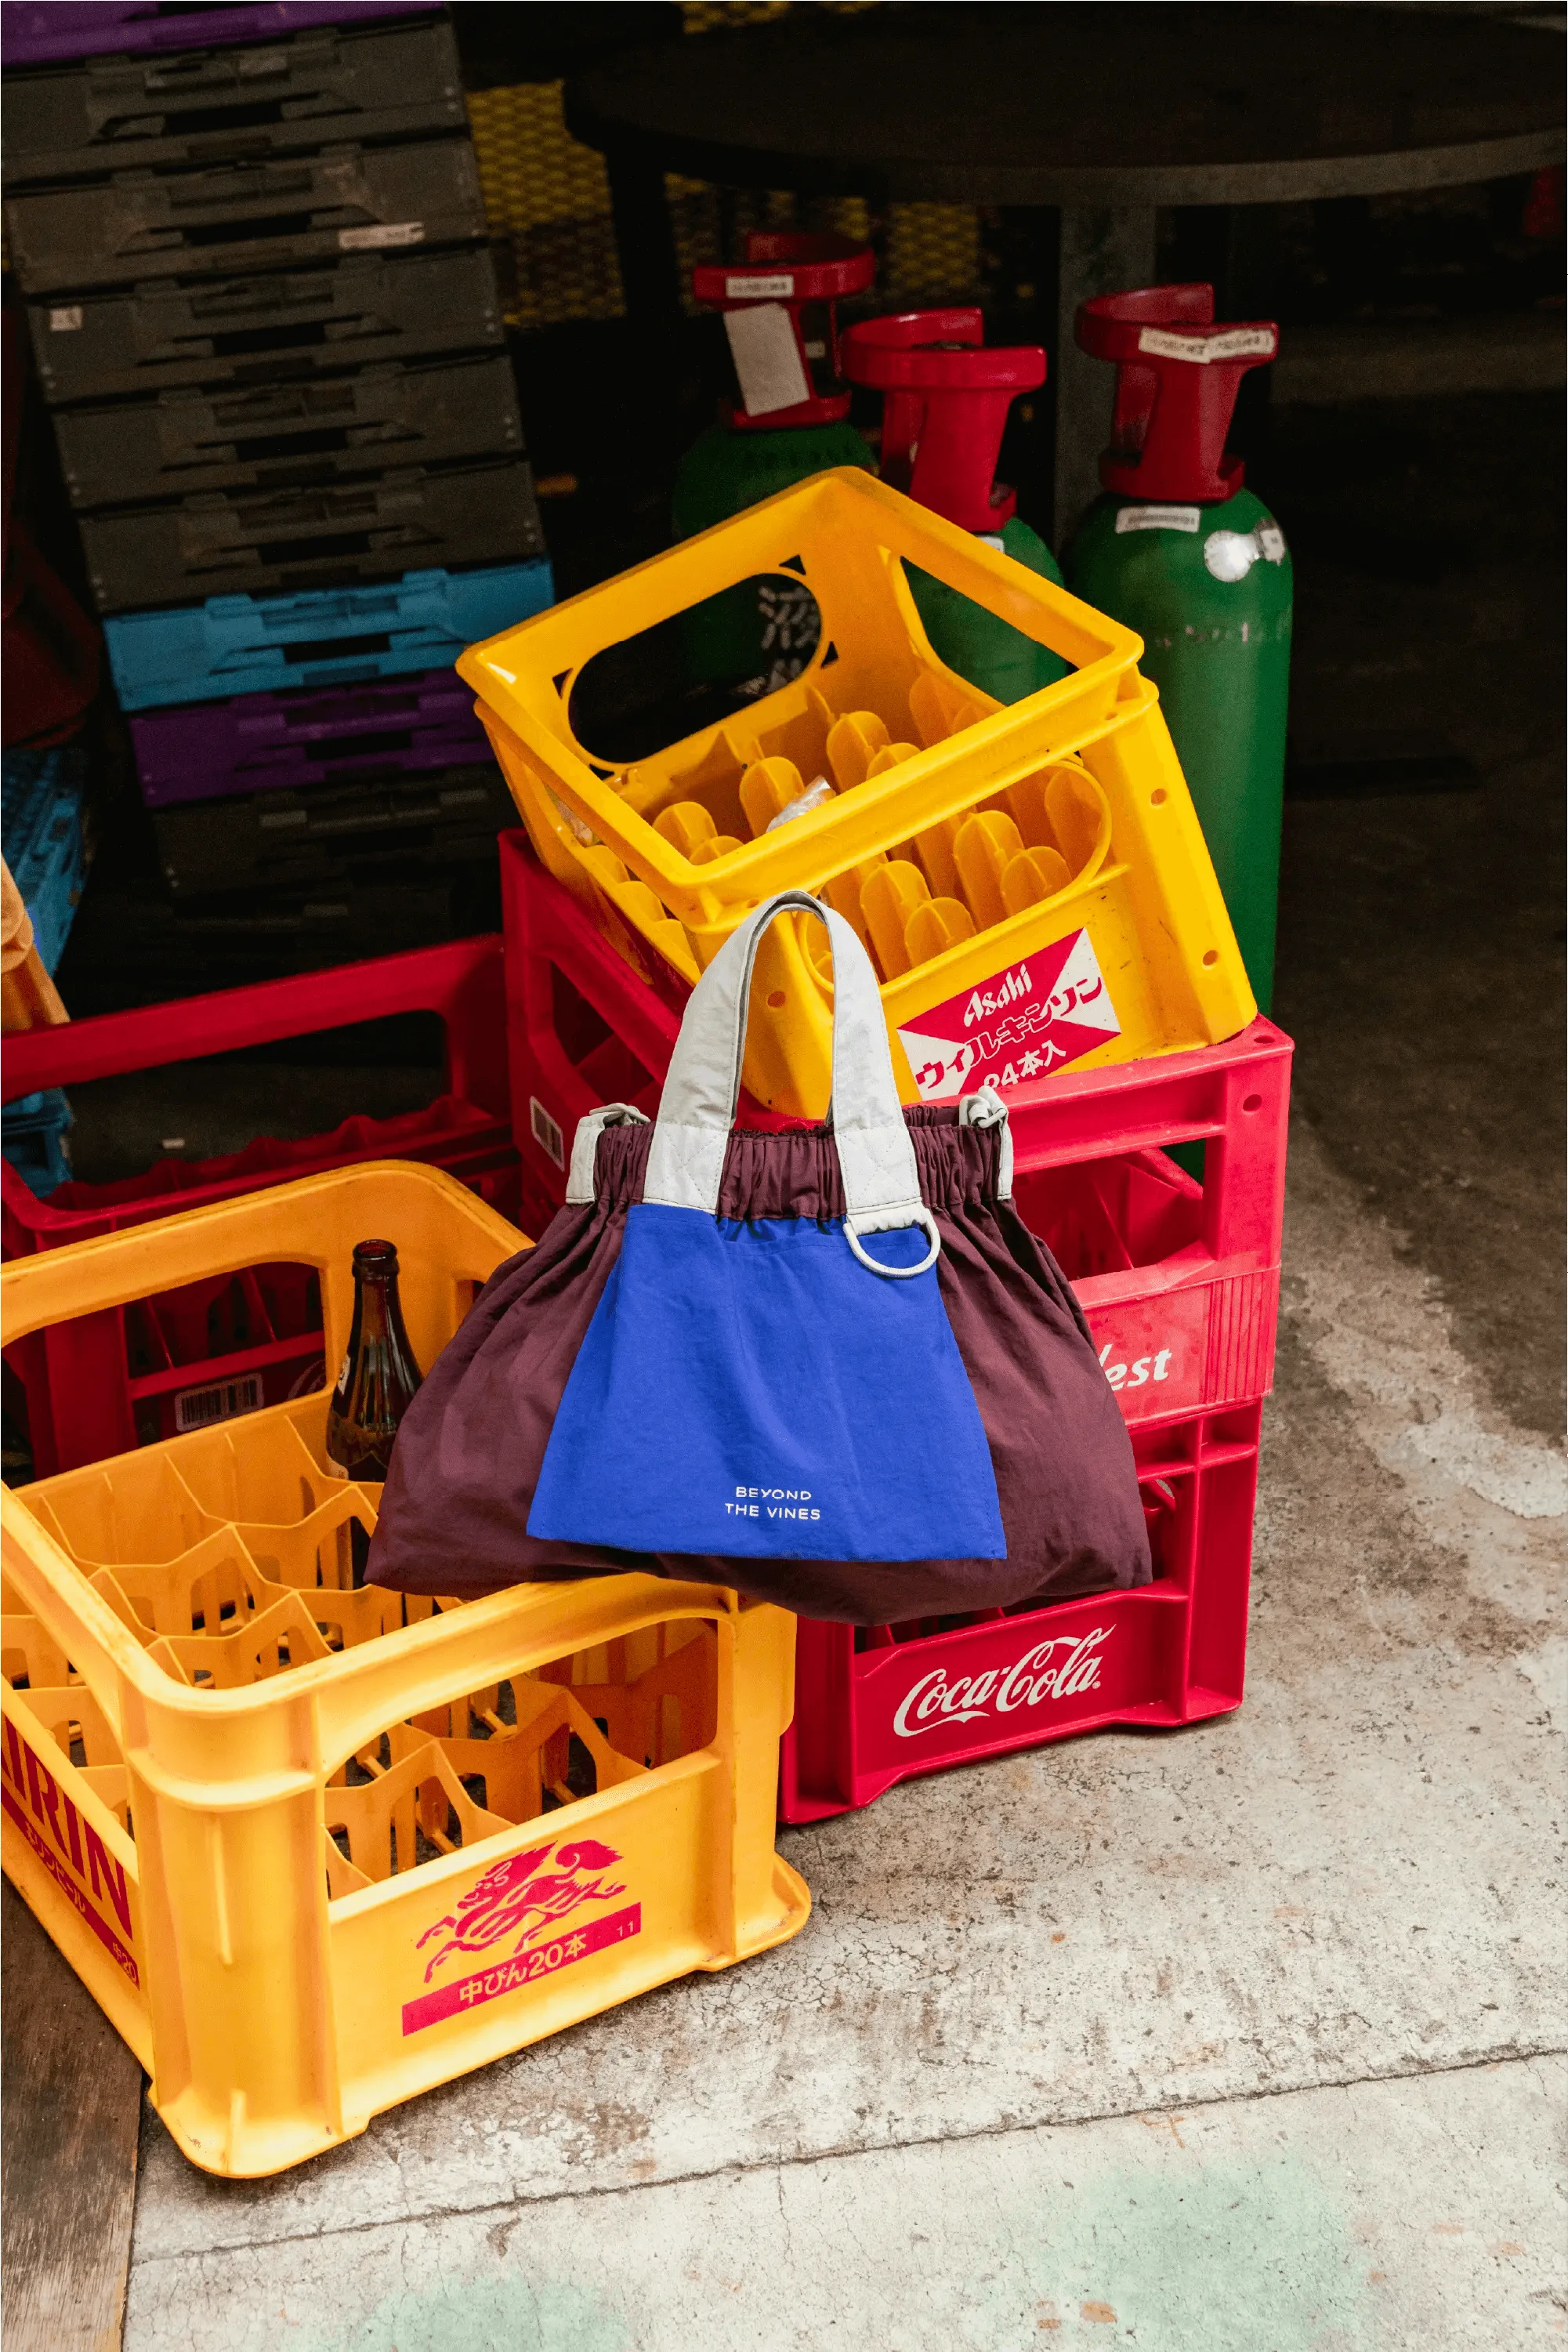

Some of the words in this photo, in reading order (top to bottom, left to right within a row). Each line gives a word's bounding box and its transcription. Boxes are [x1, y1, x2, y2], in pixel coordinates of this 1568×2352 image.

[963, 962, 1033, 1027] Asahi
[915, 976, 1103, 1089] ウィルキンソン
[725, 1502, 759, 1517] THE
[767, 1506, 820, 1520] VINES
[735, 1486, 812, 1501] BEYOND
[1, 1715, 133, 1942] IRIN
[459, 1932, 588, 2004] 中びん20本
